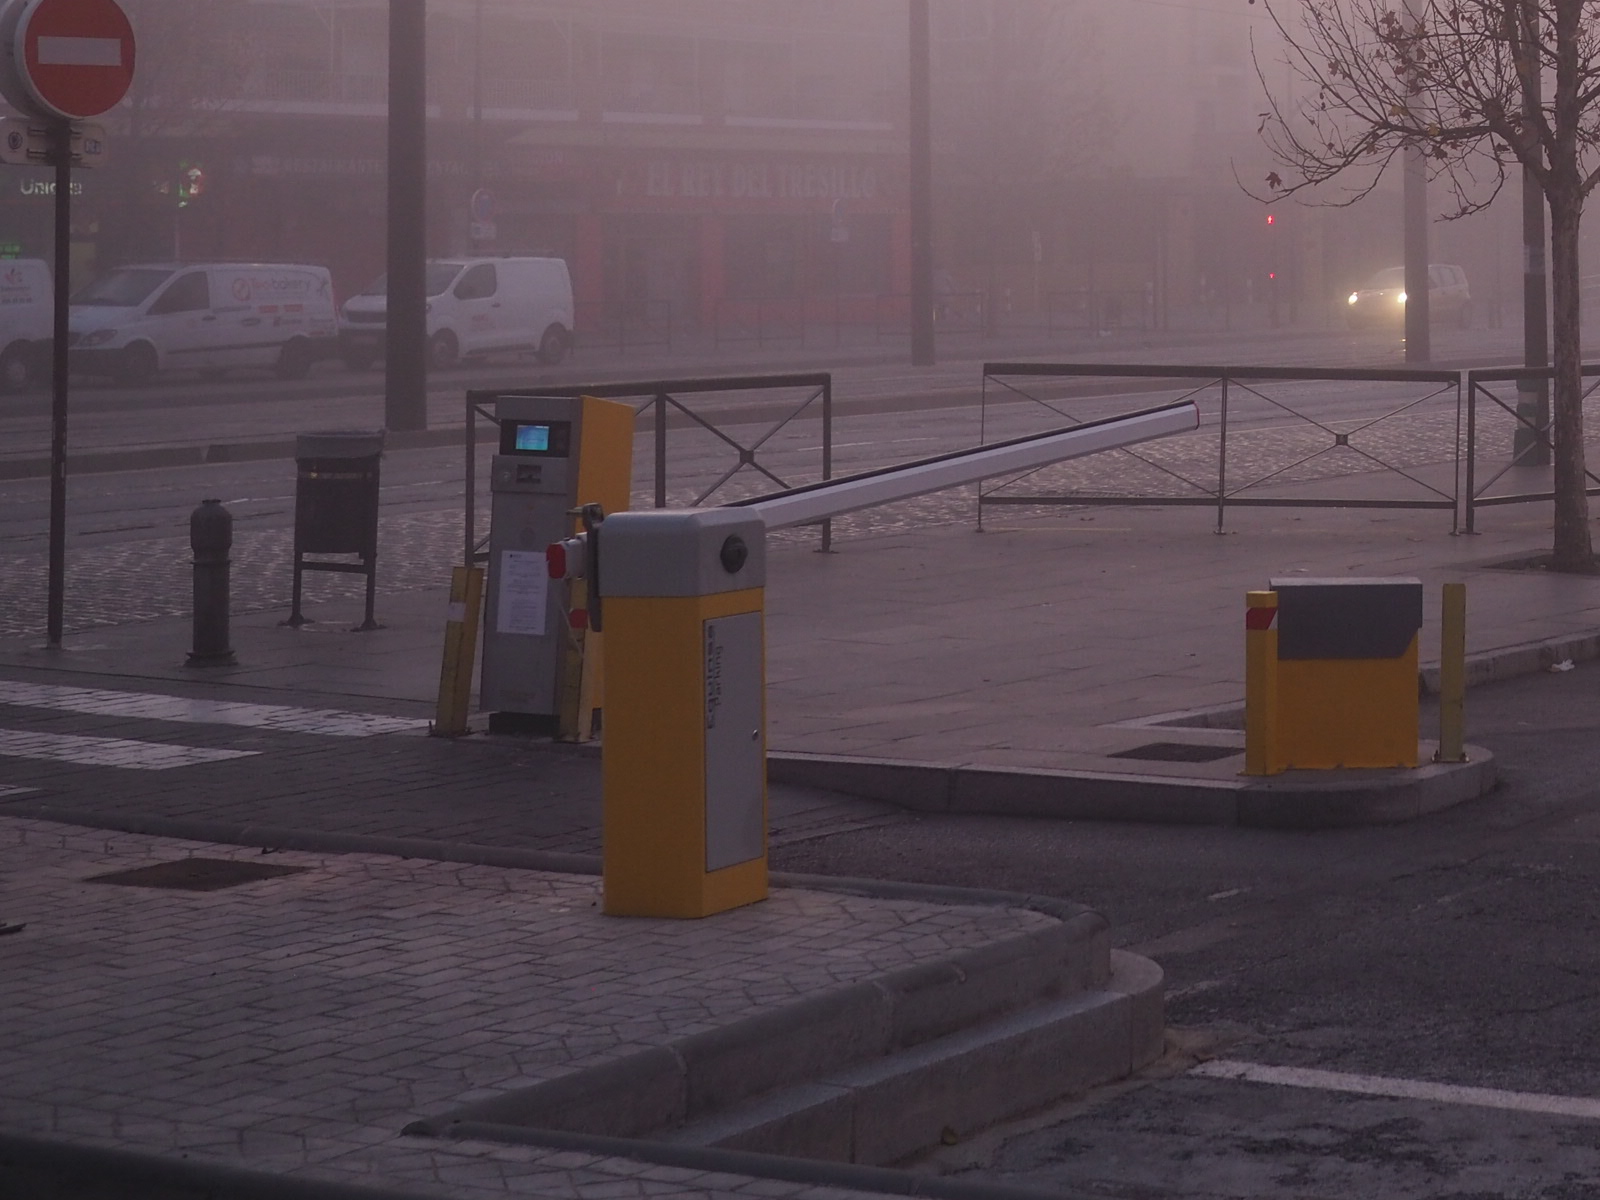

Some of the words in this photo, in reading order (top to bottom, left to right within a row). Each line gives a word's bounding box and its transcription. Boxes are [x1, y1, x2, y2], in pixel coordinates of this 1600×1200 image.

[646, 161, 674, 197] EL
[681, 161, 727, 197] REY
[732, 162, 772, 198] DEL
[778, 164, 877, 199] TRESILLO
[713, 646, 723, 706] Parking
